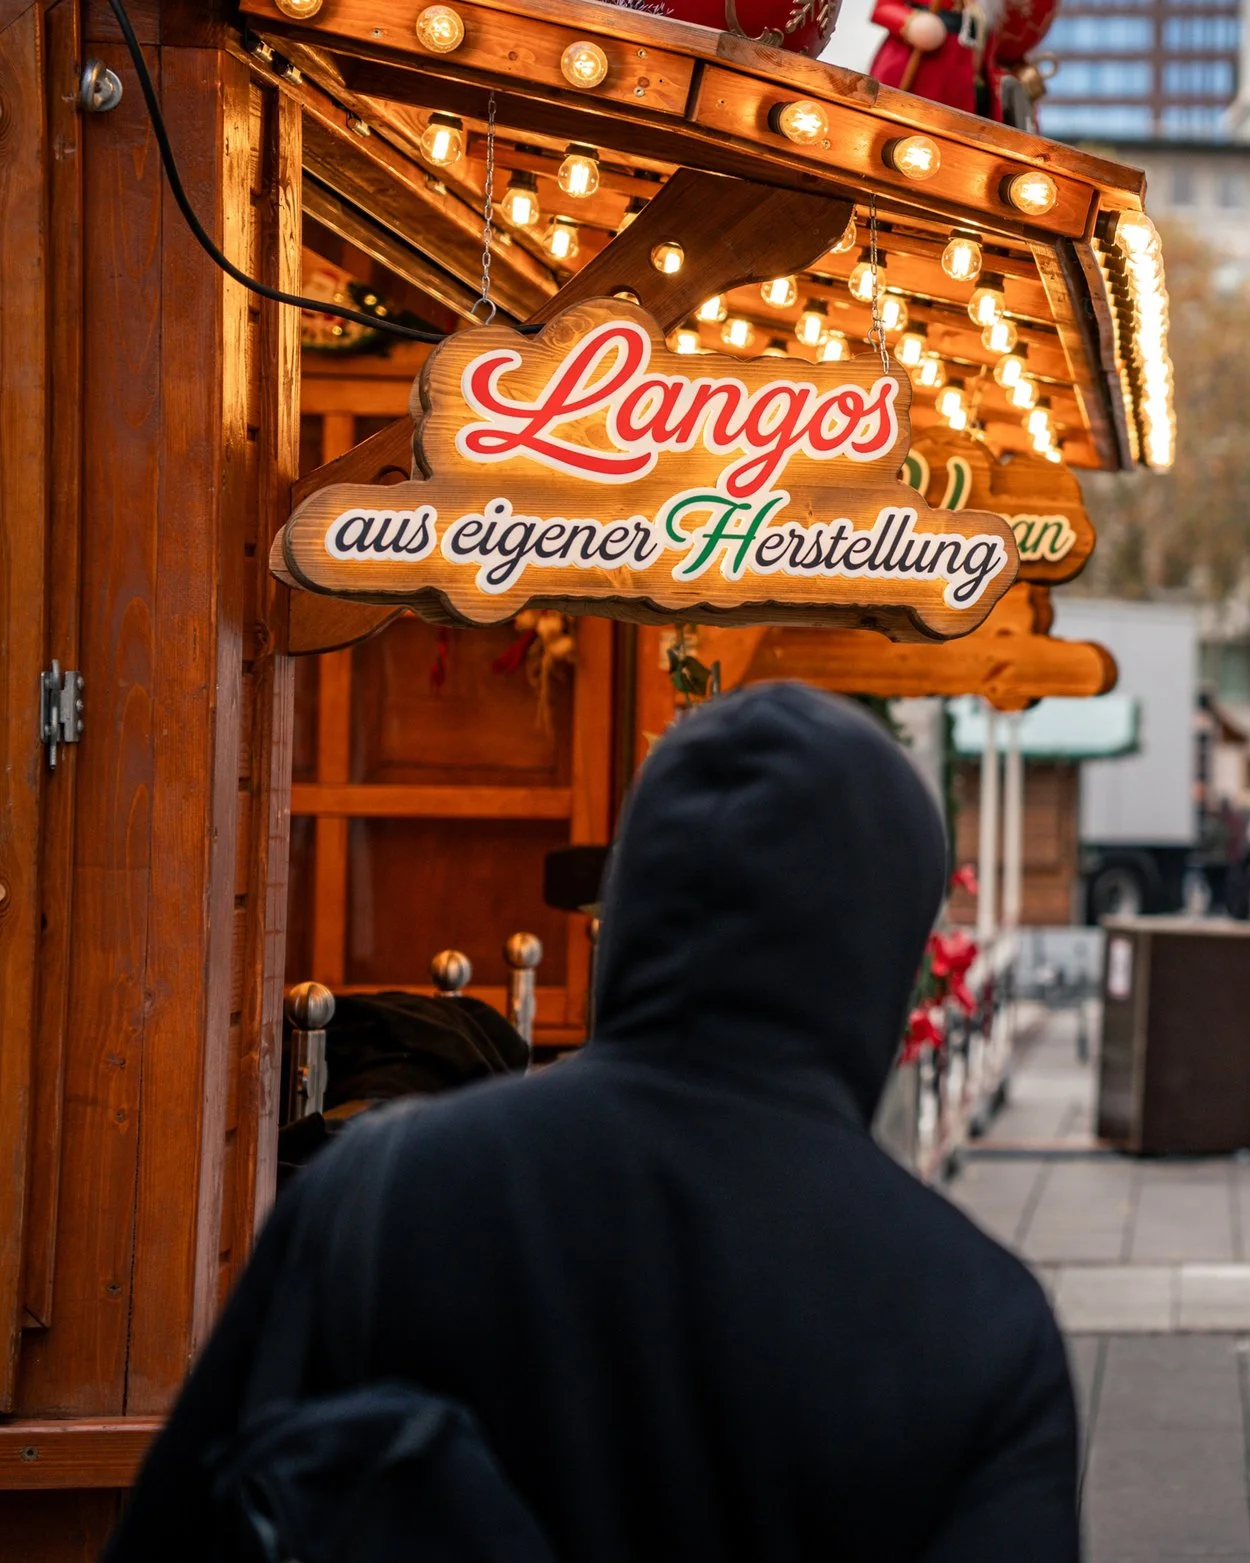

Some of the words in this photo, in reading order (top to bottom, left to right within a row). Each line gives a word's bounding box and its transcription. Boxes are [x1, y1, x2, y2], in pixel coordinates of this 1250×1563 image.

[464, 325, 893, 500] Langos
[335, 512, 430, 555] aus
[450, 503, 658, 586] eigener
[665, 493, 1001, 603] Herstellung
